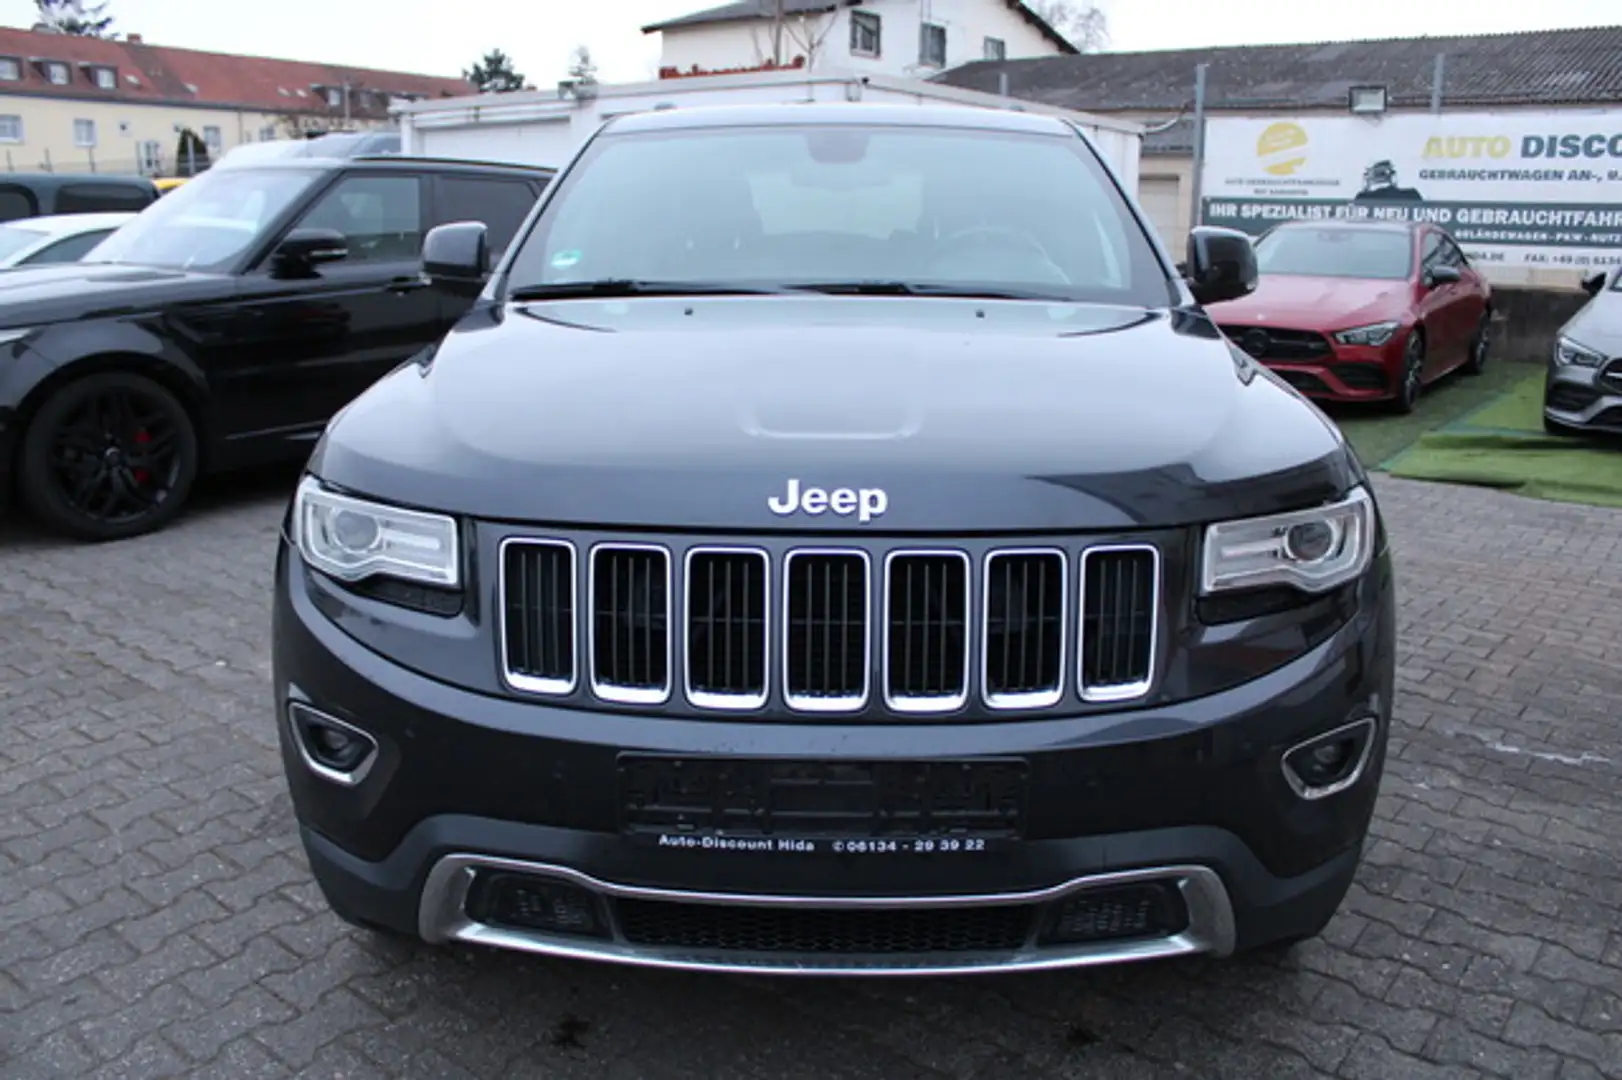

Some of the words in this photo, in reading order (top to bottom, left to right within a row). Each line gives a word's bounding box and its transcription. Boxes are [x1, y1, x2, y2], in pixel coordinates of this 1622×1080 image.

[1422, 136, 1512, 159] AUTO
[1419, 169, 1563, 181] GEBRAUCHTWAGEN
[1209, 203, 1237, 217] IHR
[1240, 204, 1333, 219] SPEZIALIST
[1335, 202, 1369, 219] FÜR
[1373, 207, 1409, 220] NEU
[1412, 207, 1452, 222] UND
[768, 478, 888, 523] Jeep
[659, 834, 773, 850] Auto-Discount
[778, 839, 815, 851] Hida
[965, 839, 985, 851] 22
